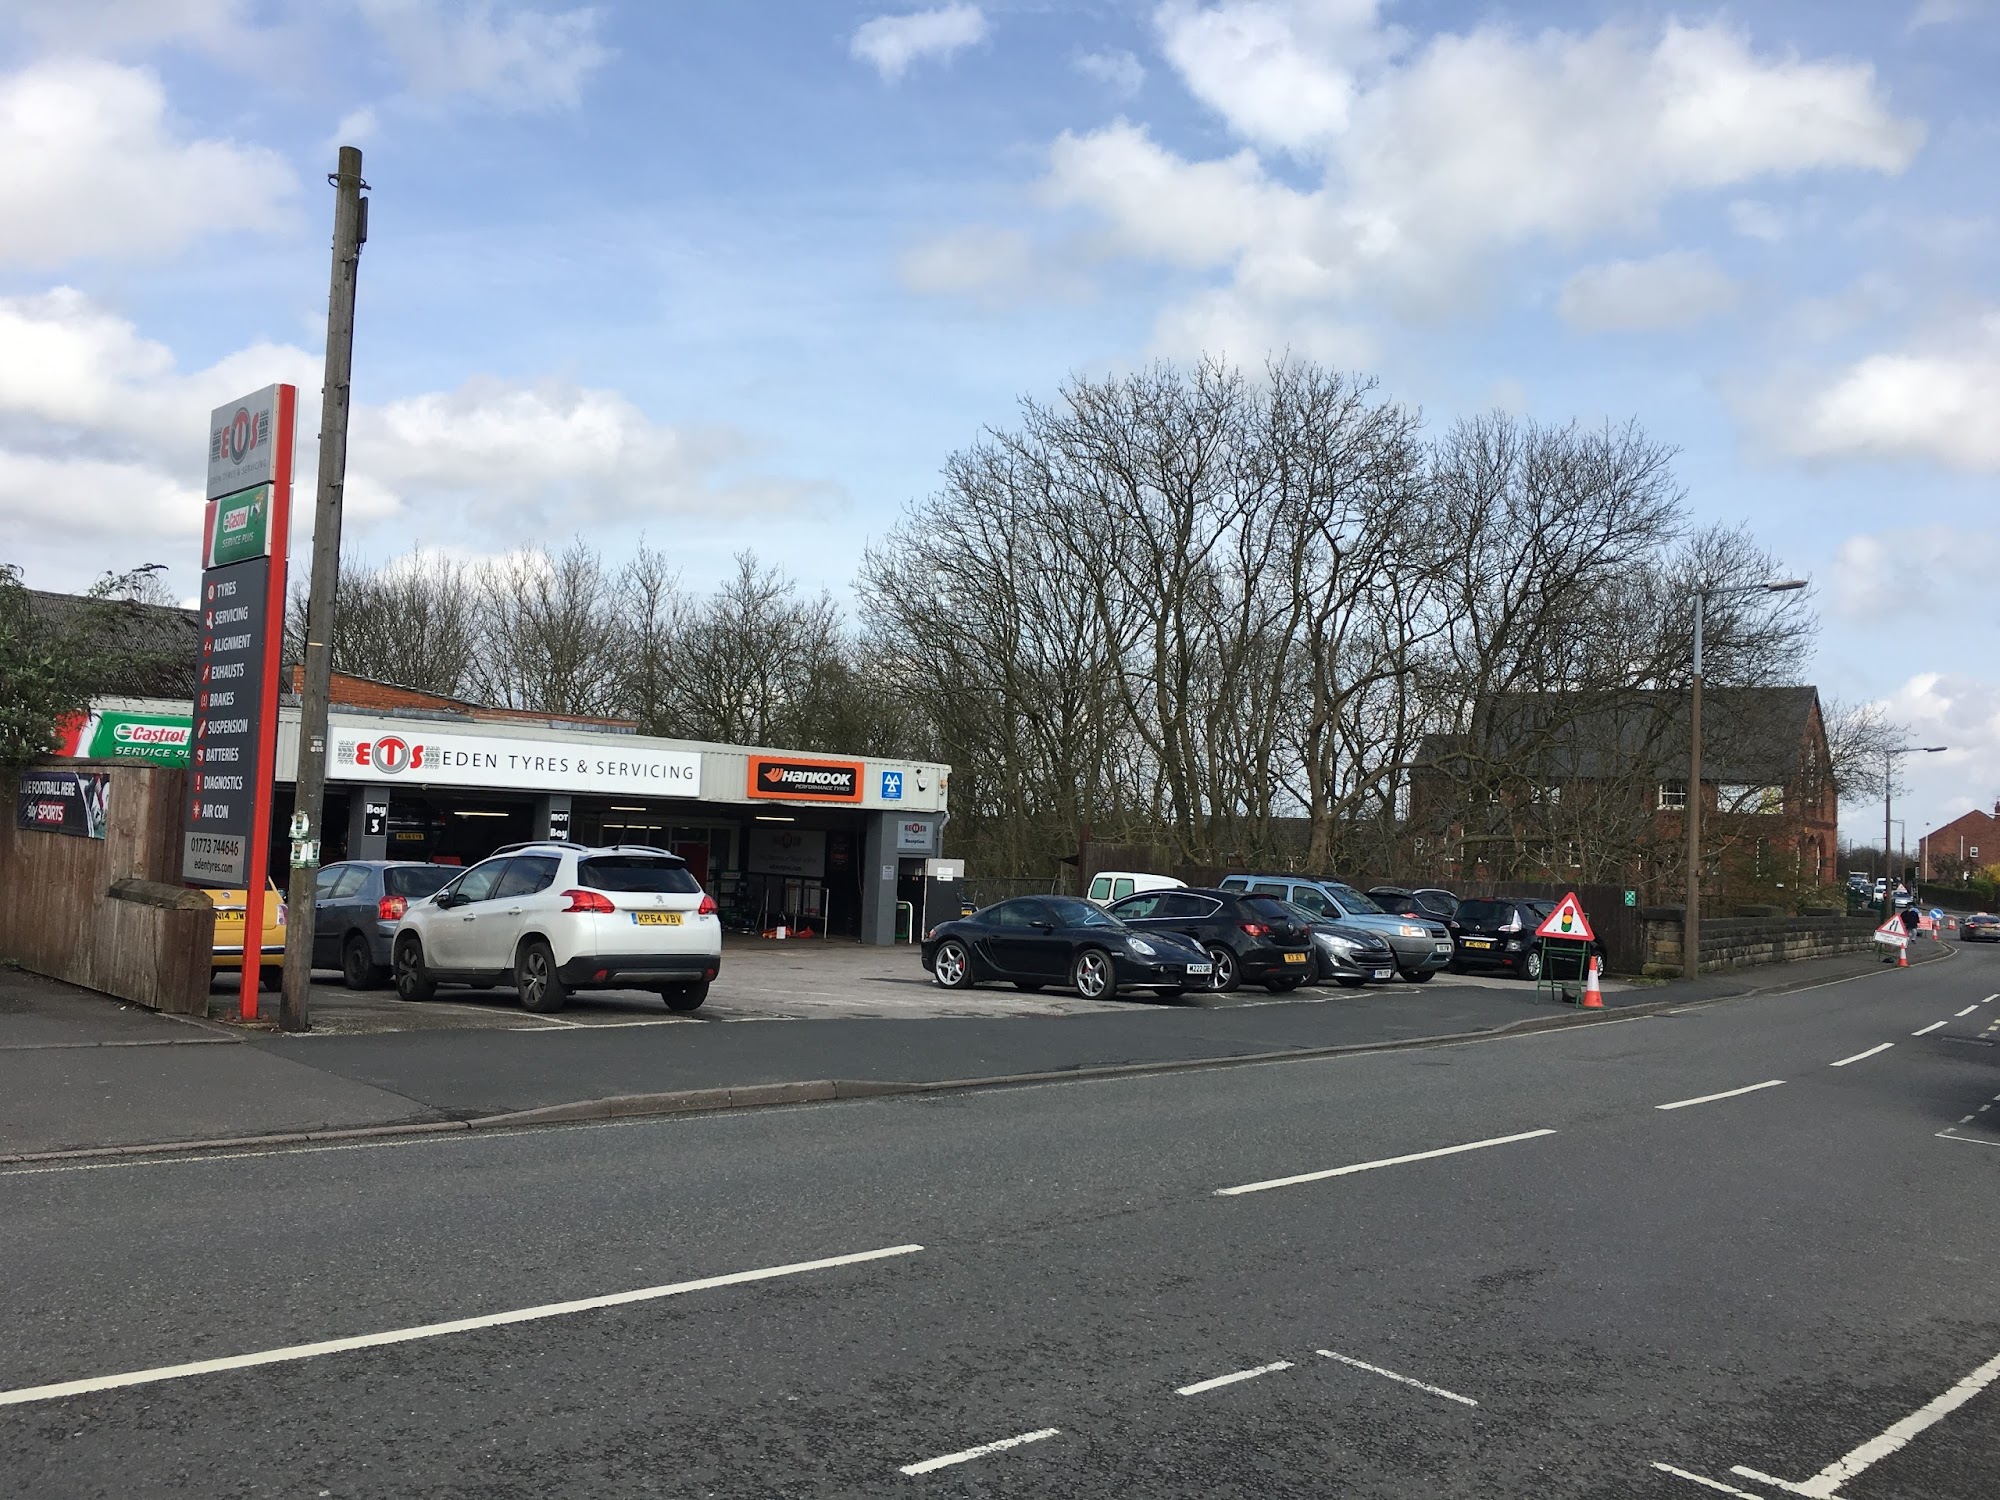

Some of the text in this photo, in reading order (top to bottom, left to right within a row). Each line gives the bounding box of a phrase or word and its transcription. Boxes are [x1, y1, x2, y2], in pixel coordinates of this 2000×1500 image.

[222, 534, 242, 548] SERVICE
[217, 580, 237, 598] TYRES
[215, 606, 249, 625] SERVICING
[213, 634, 252, 652] ALIGNMENT
[211, 663, 244, 679] EXHAUSTS
[209, 691, 234, 707] BRAKES
[133, 726, 186, 743] Castrol
[208, 719, 248, 735] SUSPENSION
[115, 746, 191, 759] SERVICE PL
[205, 747, 239, 761] BATTERIES
[356, 738, 693, 780] ETS EDEN TYRES & SERVICING
[20, 781, 75, 797] LIVE FOOTBALL HERE
[203, 776, 243, 790] DIAGNOSTICS
[795, 783, 834, 791] PERFORMANCE
[27, 802, 64, 822] sky SPORTS
[202, 804, 229, 819] AIR CON
[366, 804, 387, 818] Bay
[551, 813, 569, 821] MOT
[371, 818, 380, 833] 3
[550, 828, 567, 840] Bay
[191, 837, 239, 856] 01773 744646
[194, 858, 233, 873] edentyres.com
[215, 912, 230, 920] N14
[637, 913, 682, 923] KP64 VBV
